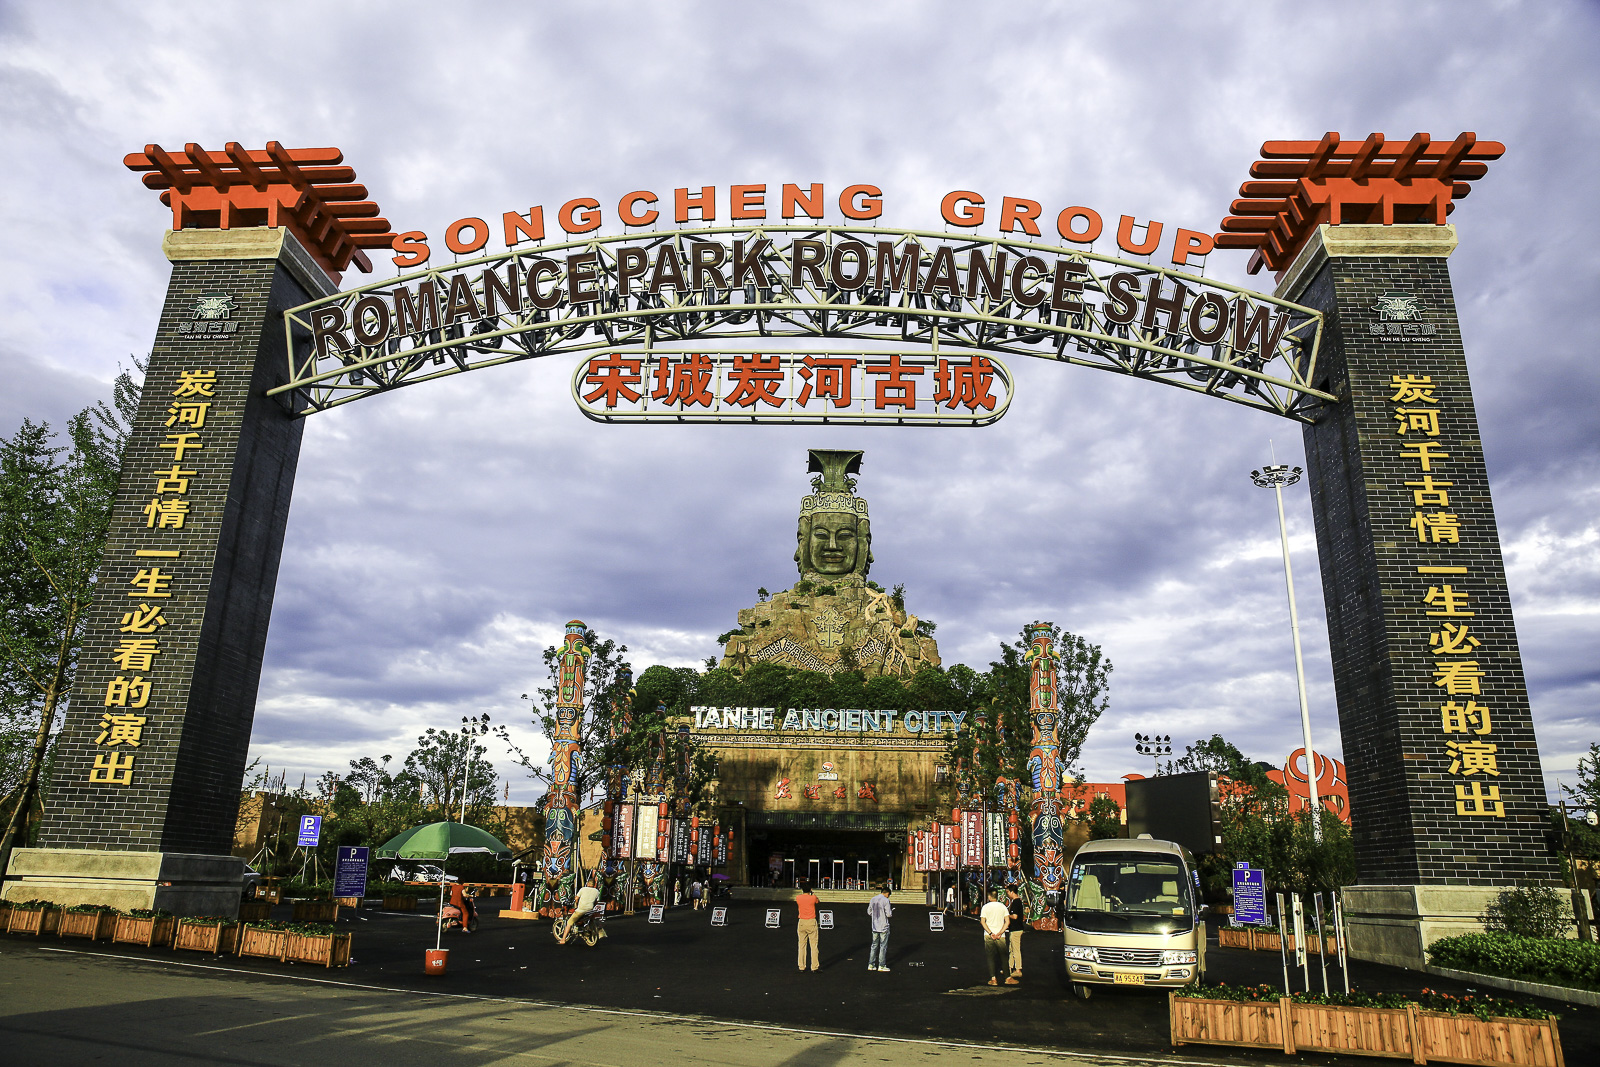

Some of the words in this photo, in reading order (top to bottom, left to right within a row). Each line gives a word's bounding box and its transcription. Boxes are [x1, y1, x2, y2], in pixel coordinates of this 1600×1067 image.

[391, 183, 884, 267] SONGCHENG
[940, 189, 1215, 265] GROUP
[310, 250, 601, 361] ROMANCE
[616, 238, 773, 298] PARK
[789, 238, 1089, 315] ROMANCE
[1102, 272, 1290, 361] SHOW
[583, 352, 998, 411] 宋城炭河古城
[690, 705, 775, 730] TANHE
[781, 708, 897, 733] ANCIENT
[903, 710, 967, 734] CITY
[303, 817, 315, 829] P
[351, 848, 357, 858] P
[1244, 870, 1251, 882] P
